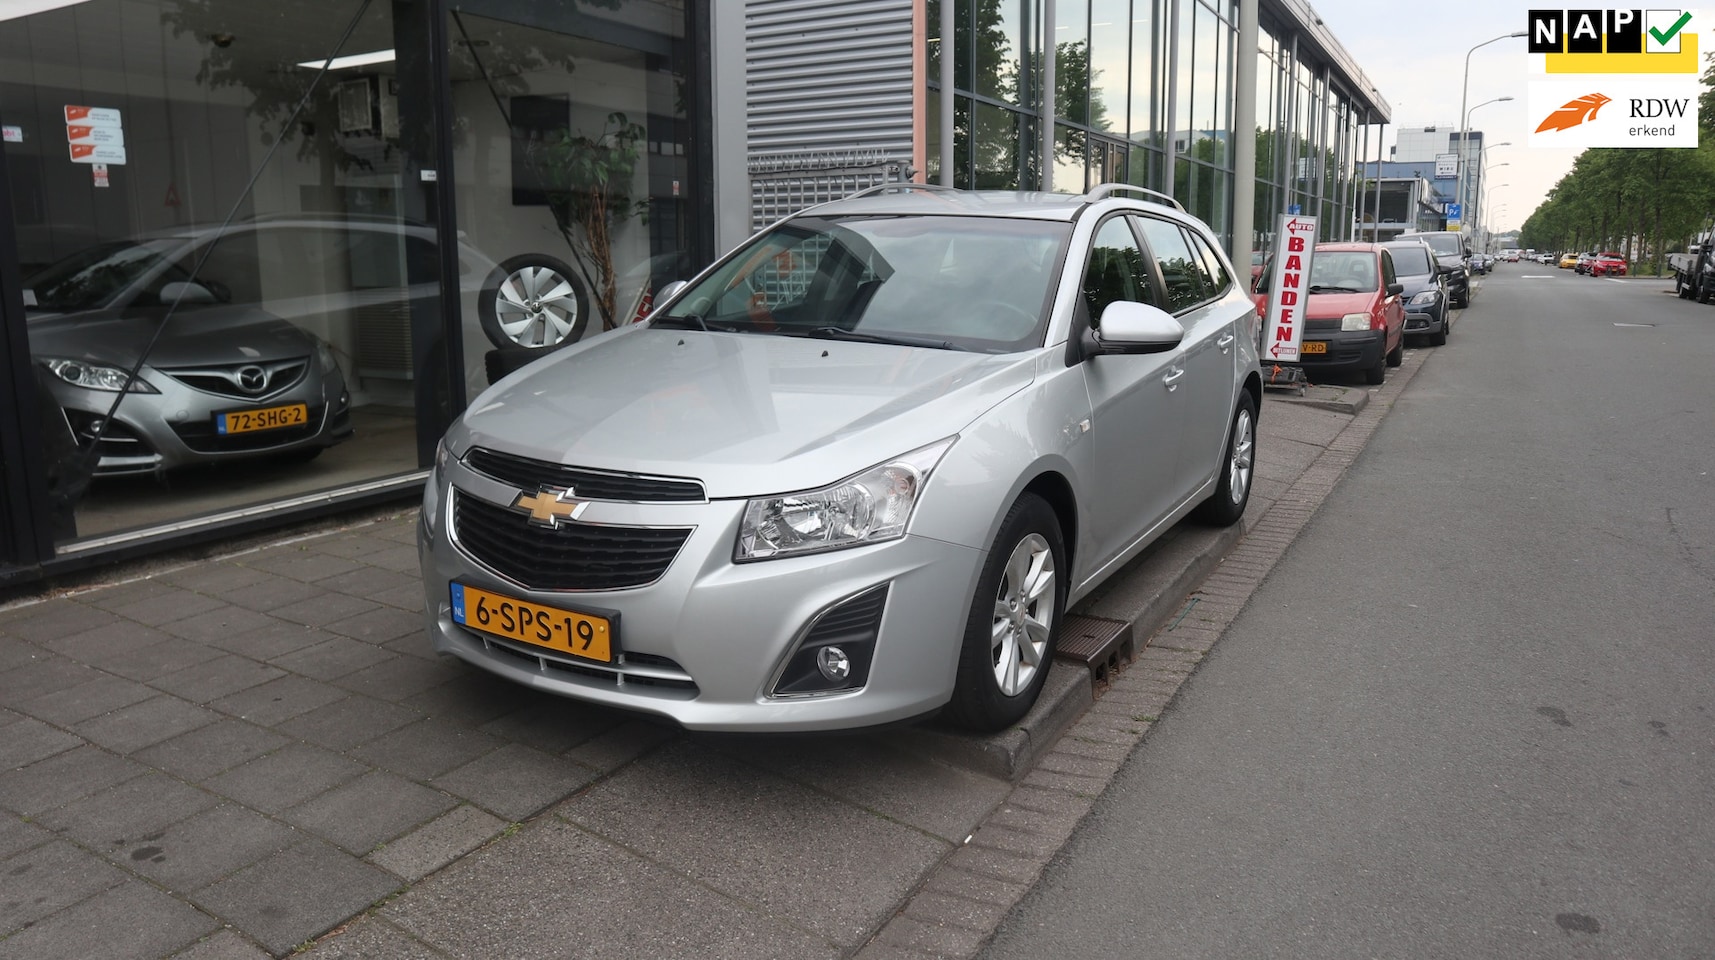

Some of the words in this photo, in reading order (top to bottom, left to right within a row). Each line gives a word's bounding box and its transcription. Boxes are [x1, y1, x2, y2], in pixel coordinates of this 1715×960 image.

[1276, 236, 1305, 342] BANDEN
[231, 407, 302, 431] 72-SHG-2
[454, 606, 465, 618] NL
[476, 596, 594, 651] 6-SPS-19
